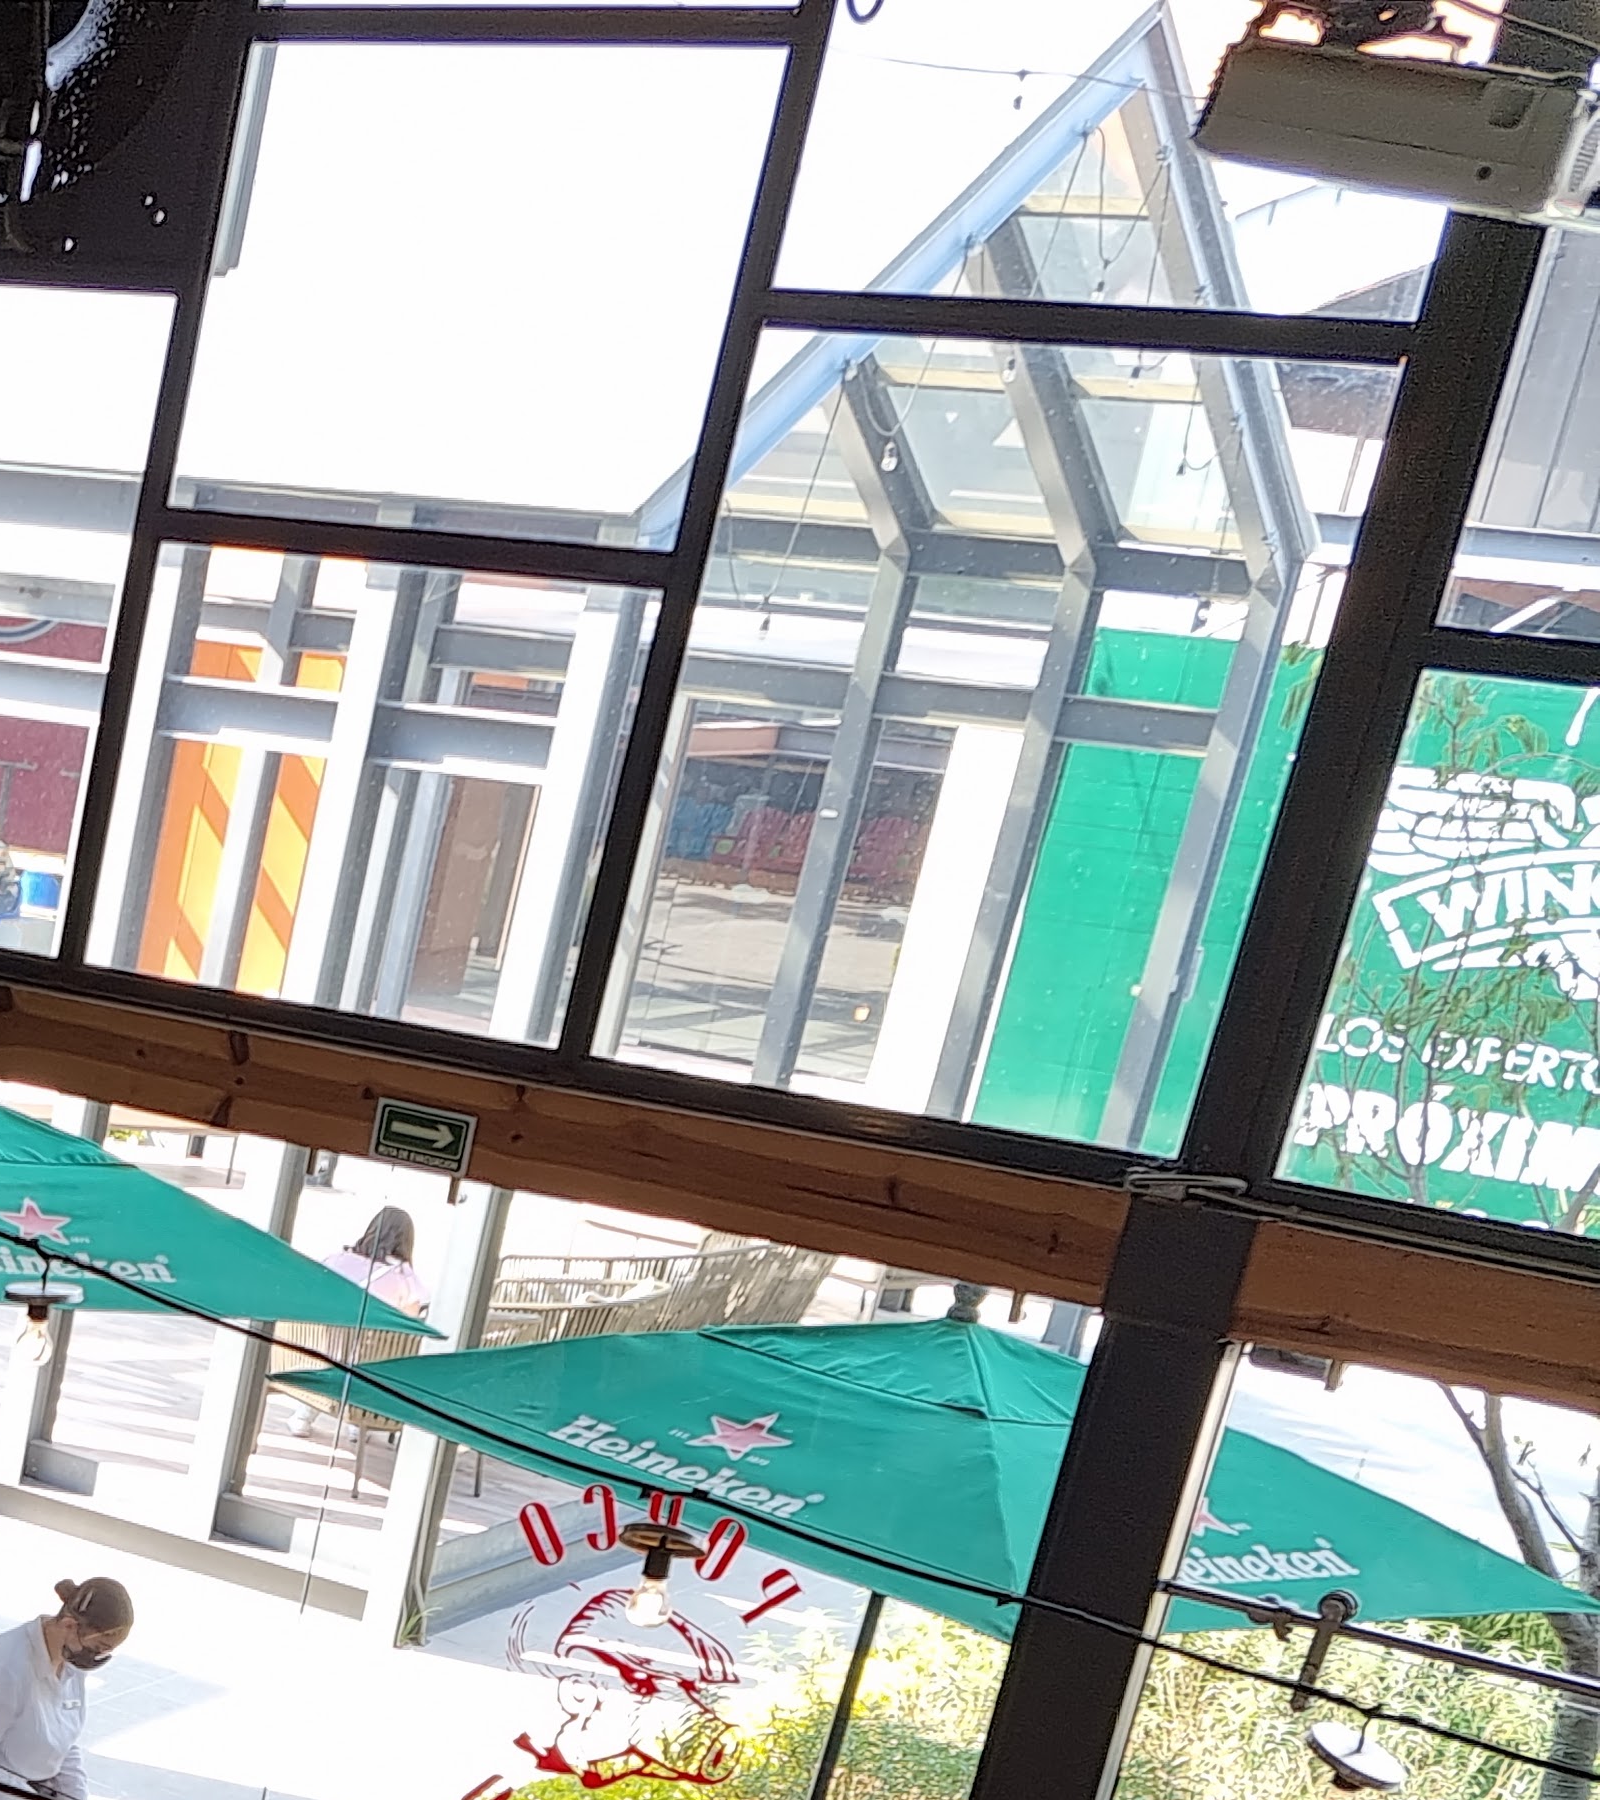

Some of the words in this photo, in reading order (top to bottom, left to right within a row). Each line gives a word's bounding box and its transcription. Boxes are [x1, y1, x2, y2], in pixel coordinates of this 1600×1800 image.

[1416, 864, 1600, 938] WIN
[1316, 1014, 1405, 1062] LOS
[1294, 1083, 1600, 1195] PRÓXIM
[547, 1415, 825, 1518] Heineken
[1176, 1537, 1360, 1584] eineken
